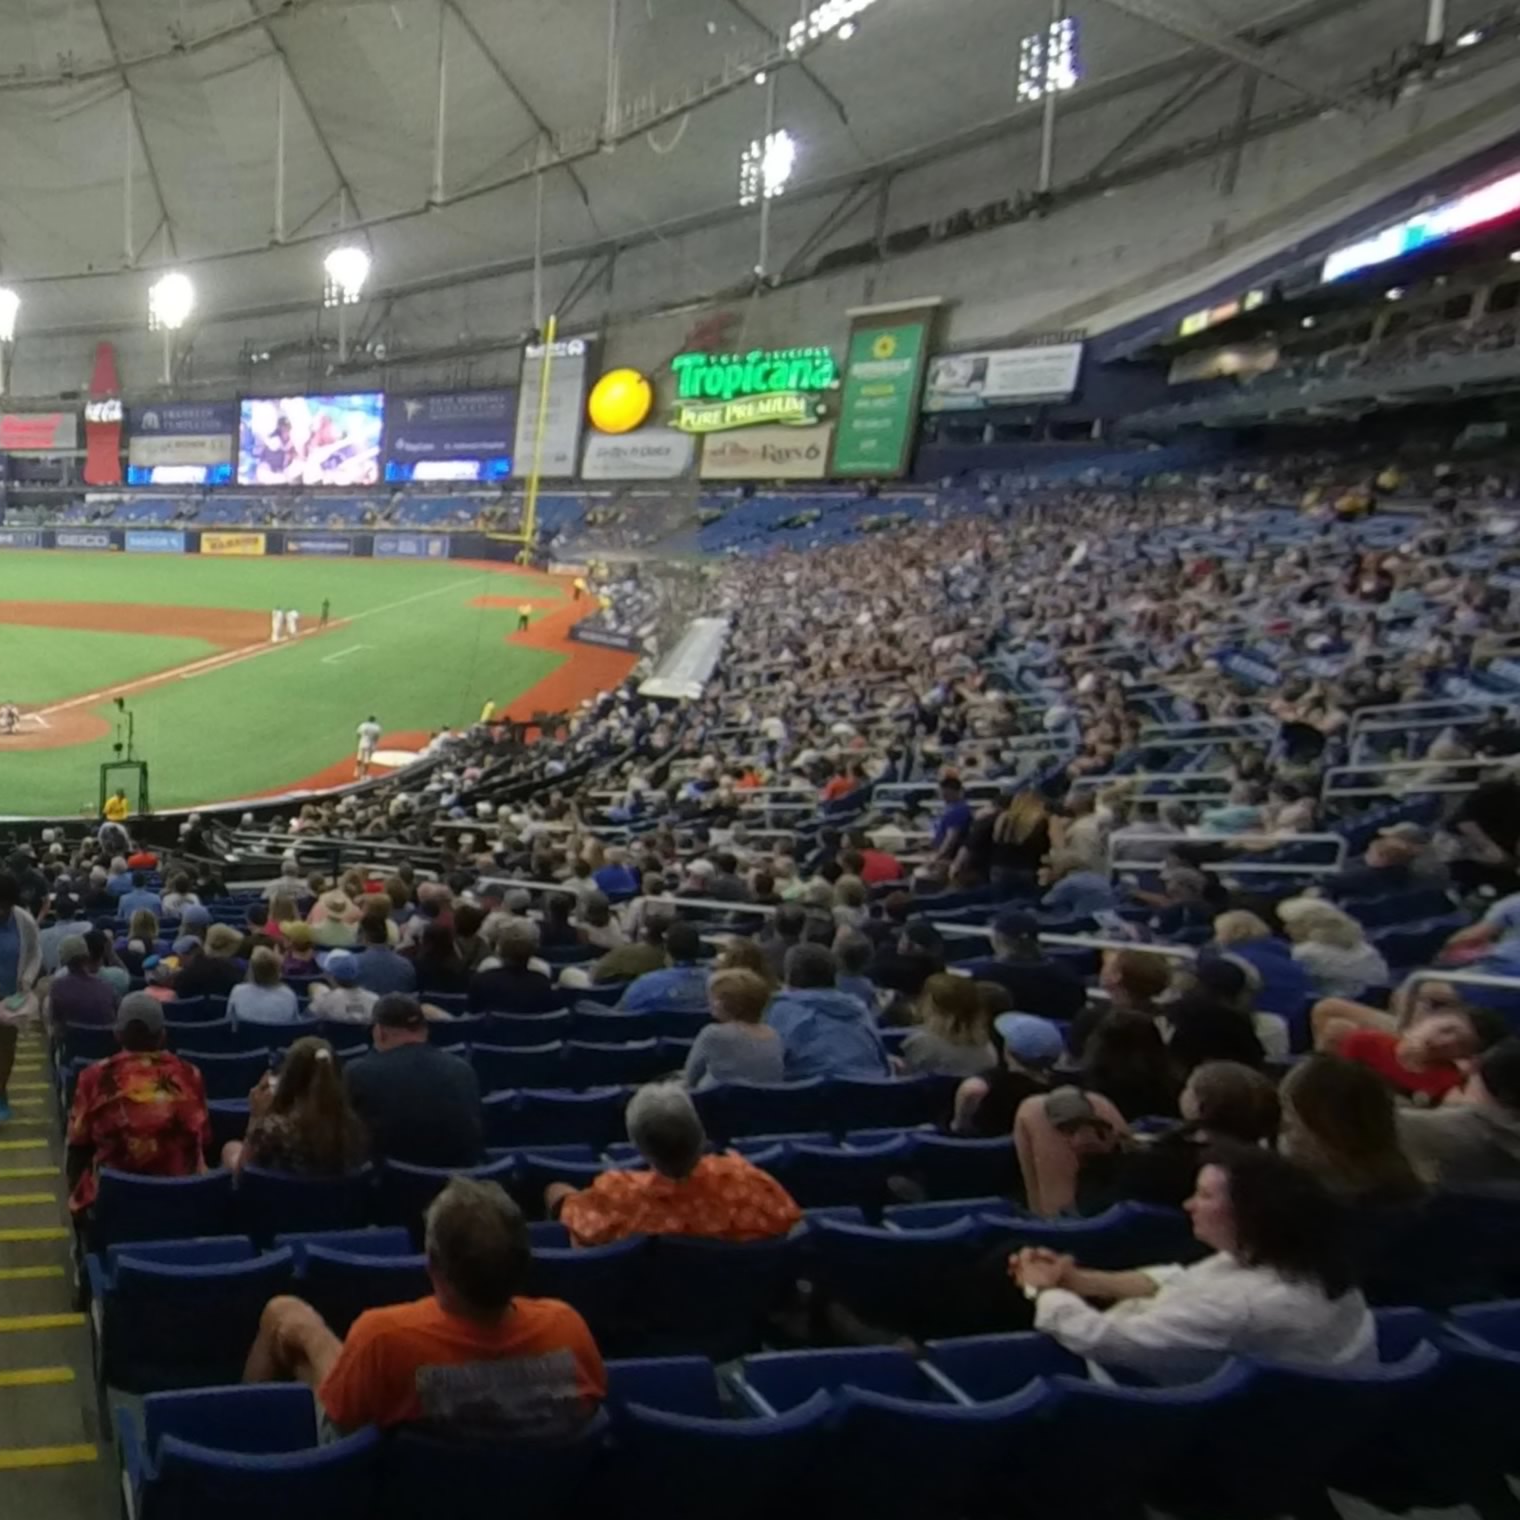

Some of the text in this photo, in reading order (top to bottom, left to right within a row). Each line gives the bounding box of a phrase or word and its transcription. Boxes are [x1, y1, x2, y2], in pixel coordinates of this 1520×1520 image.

[672, 352, 834, 399] Tropicana
[679, 396, 805, 427] PURE PREMIUM
[57, 533, 108, 547] GEICO
